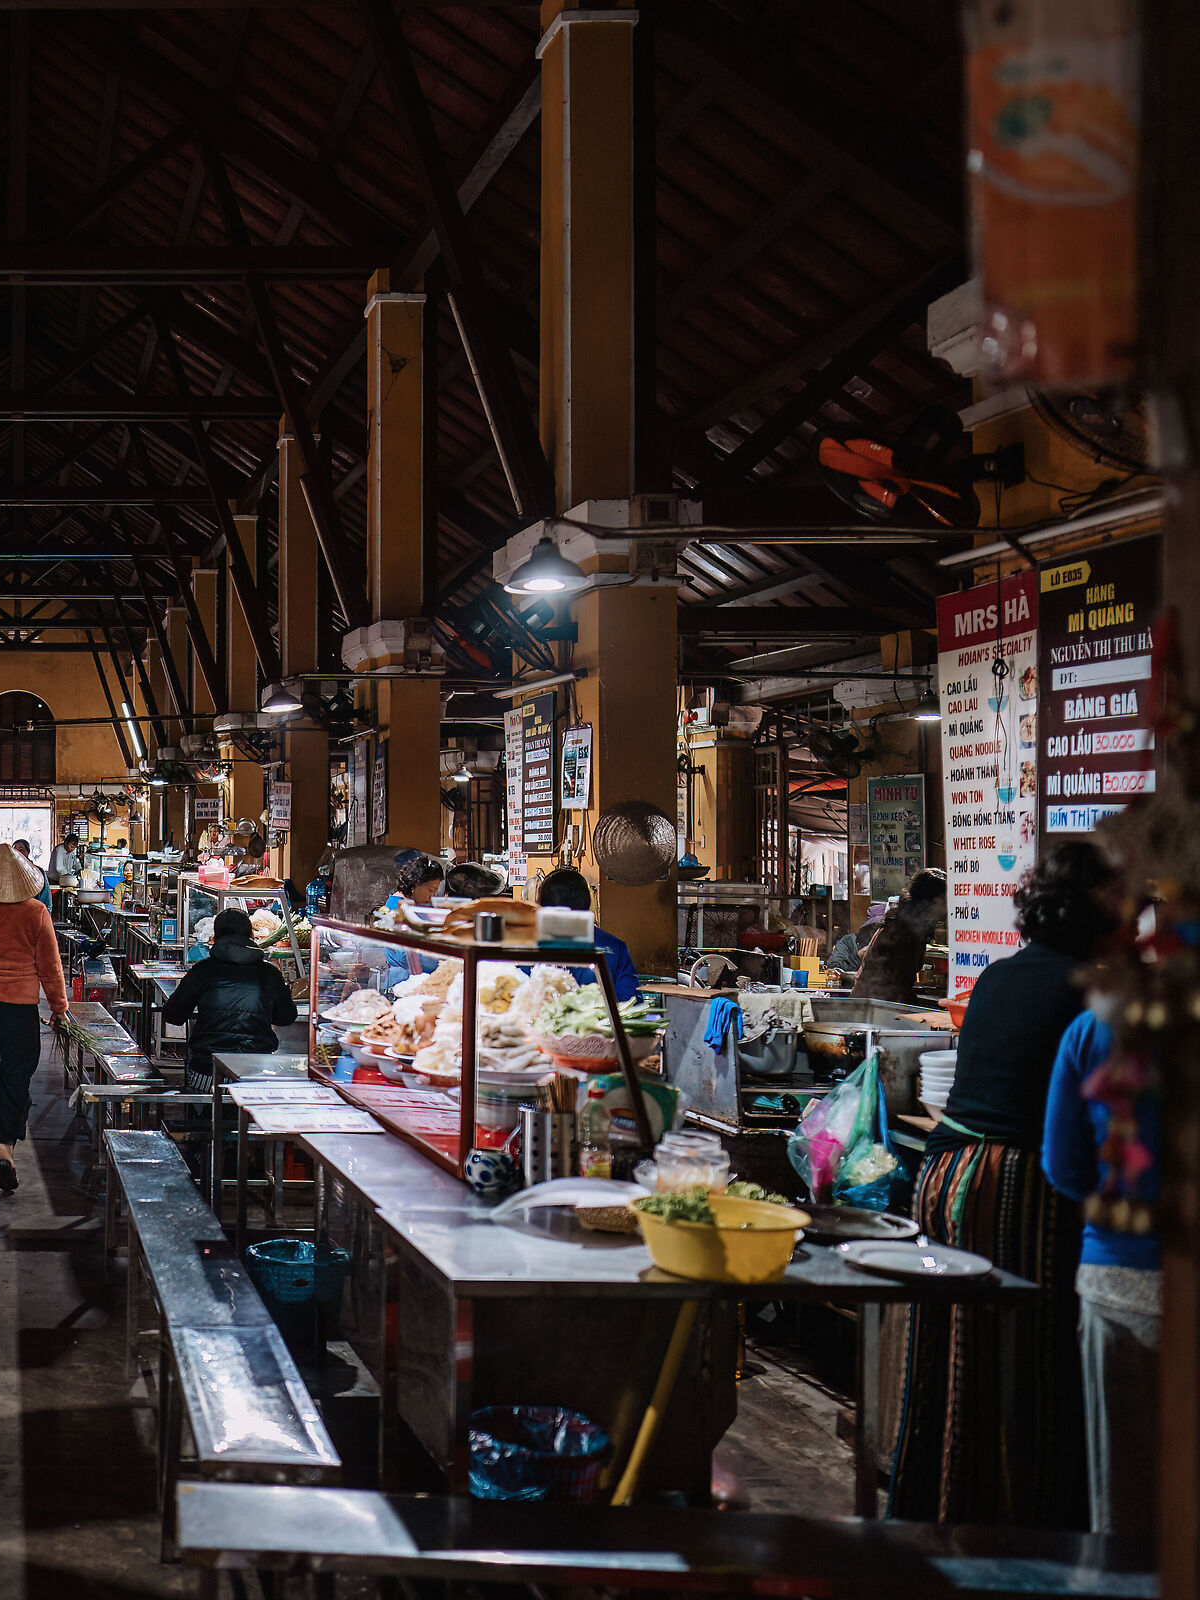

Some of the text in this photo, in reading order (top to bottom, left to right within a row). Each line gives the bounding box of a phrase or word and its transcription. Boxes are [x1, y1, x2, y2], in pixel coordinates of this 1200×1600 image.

[954, 589, 1030, 638] MRS HÀ
[1068, 608, 1085, 633] MÌ
[958, 636, 1032, 667] HOIAN'S SPECIALTY
[1092, 638, 1112, 659] THỊ
[1114, 634, 1136, 654] THU
[1138, 625, 1154, 650] HÀ
[947, 681, 961, 696] CAO
[948, 697, 978, 714] CAO LAU
[1064, 688, 1139, 720] BẢNG GIÁ
[949, 716, 984, 737] MÌ QUẢNG
[949, 740, 1002, 760] QUANG NOODLE
[1047, 736, 1069, 758] CAO
[1095, 734, 1136, 751] 30.000
[1047, 767, 1101, 798] MÌ QUẢNG
[951, 790, 984, 804] WON TON
[1050, 807, 1068, 827] BÚN
[953, 836, 996, 850] WHITE ROSE
[954, 855, 968, 873] PHỞ
[954, 884, 1017, 897] BEEF NOODLE SOUP
[955, 902, 969, 919] PHỞ
[955, 930, 1020, 946] CHICKEN NOODLE SOUP
[956, 952, 971, 966] RAM
